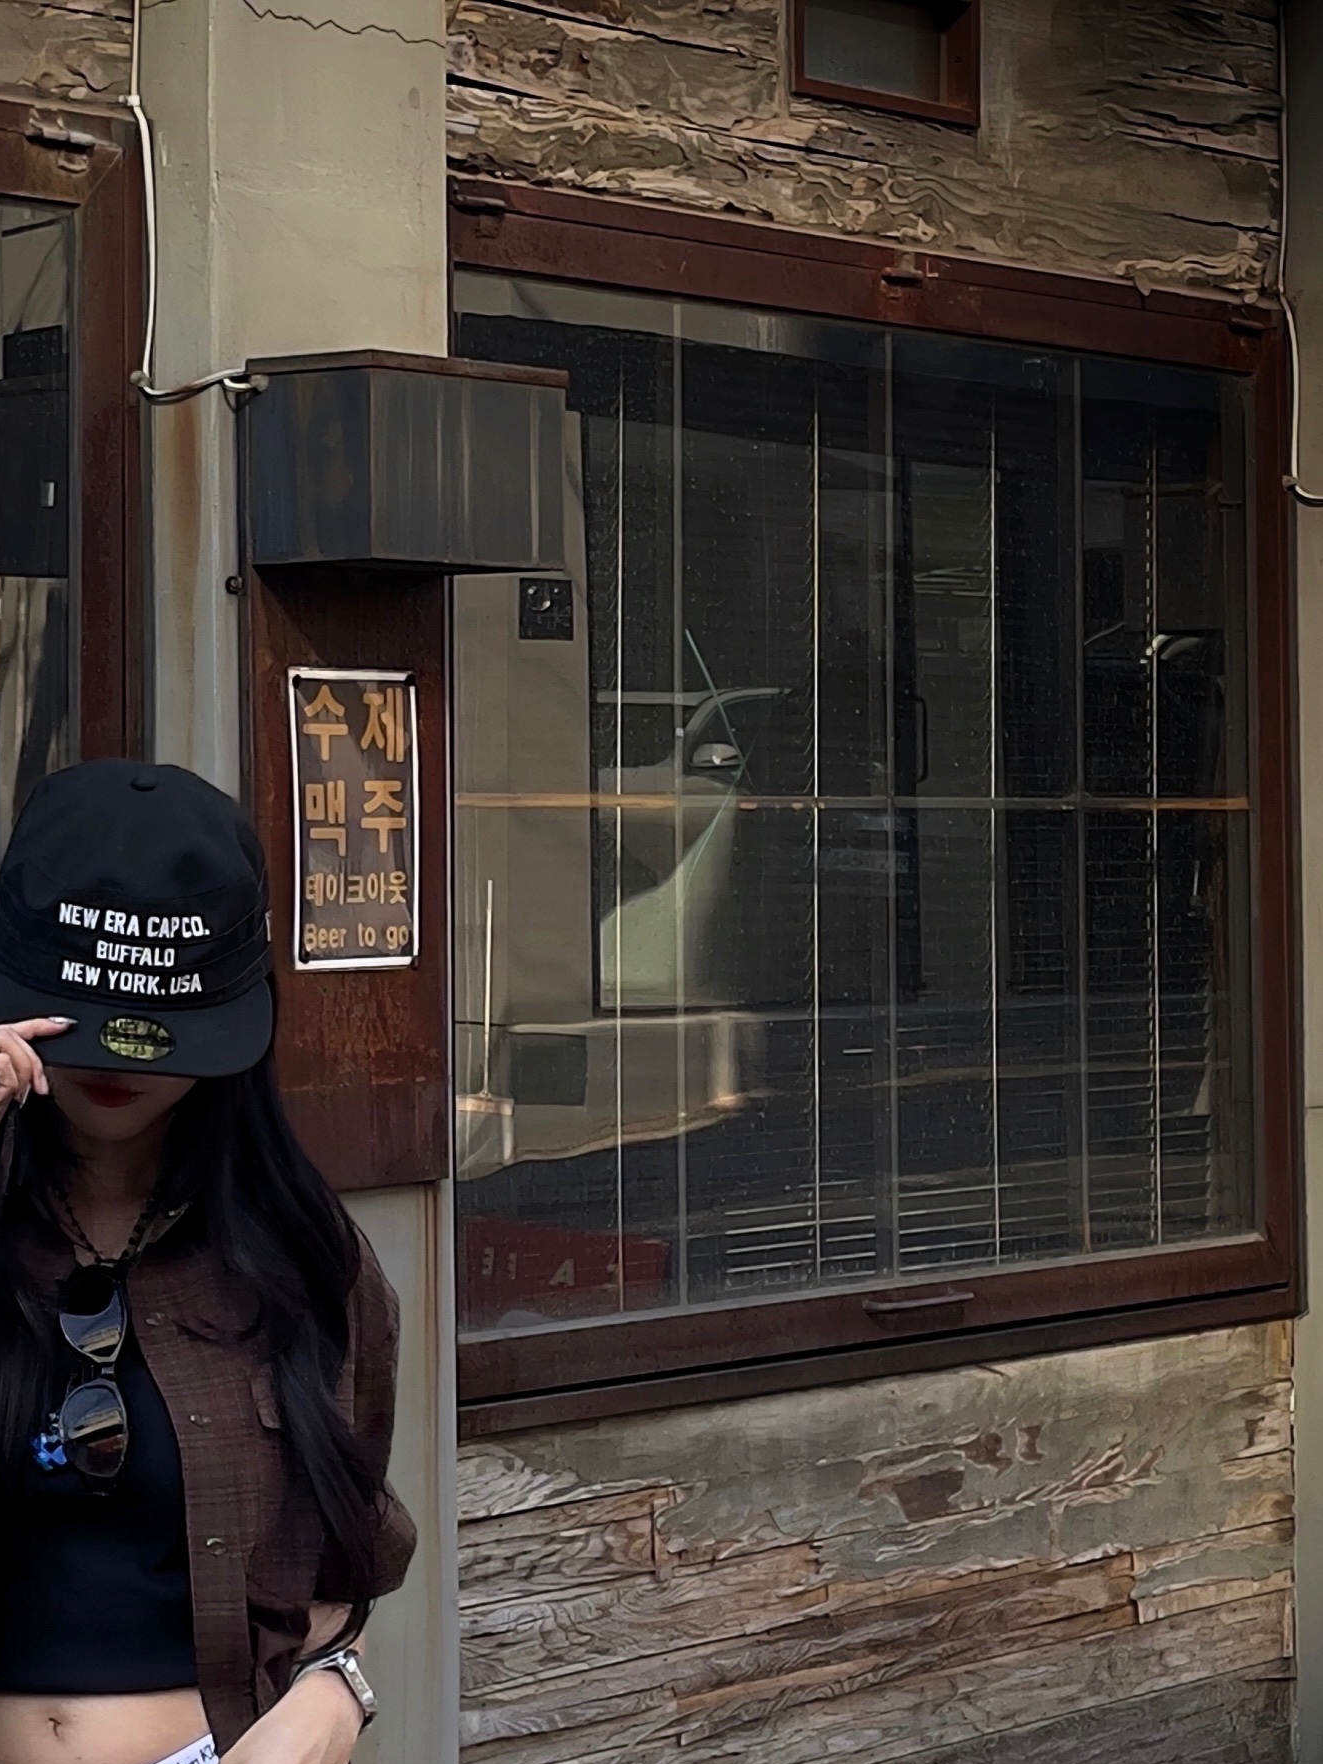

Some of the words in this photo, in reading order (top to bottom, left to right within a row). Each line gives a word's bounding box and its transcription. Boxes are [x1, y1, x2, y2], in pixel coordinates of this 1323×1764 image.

[303, 684, 405, 763] 수제
[305, 780, 407, 857] 맥주
[305, 870, 408, 907] 테이크아웃
[59, 903, 100, 930] NEW
[104, 910, 140, 937] ERA
[304, 923, 347, 951] Beer
[358, 922, 376, 947] to
[386, 924, 409, 950] go
[96, 940, 175, 967] BUFFALO
[61, 960, 100, 987] NEW
[170, 973, 202, 995] USA
